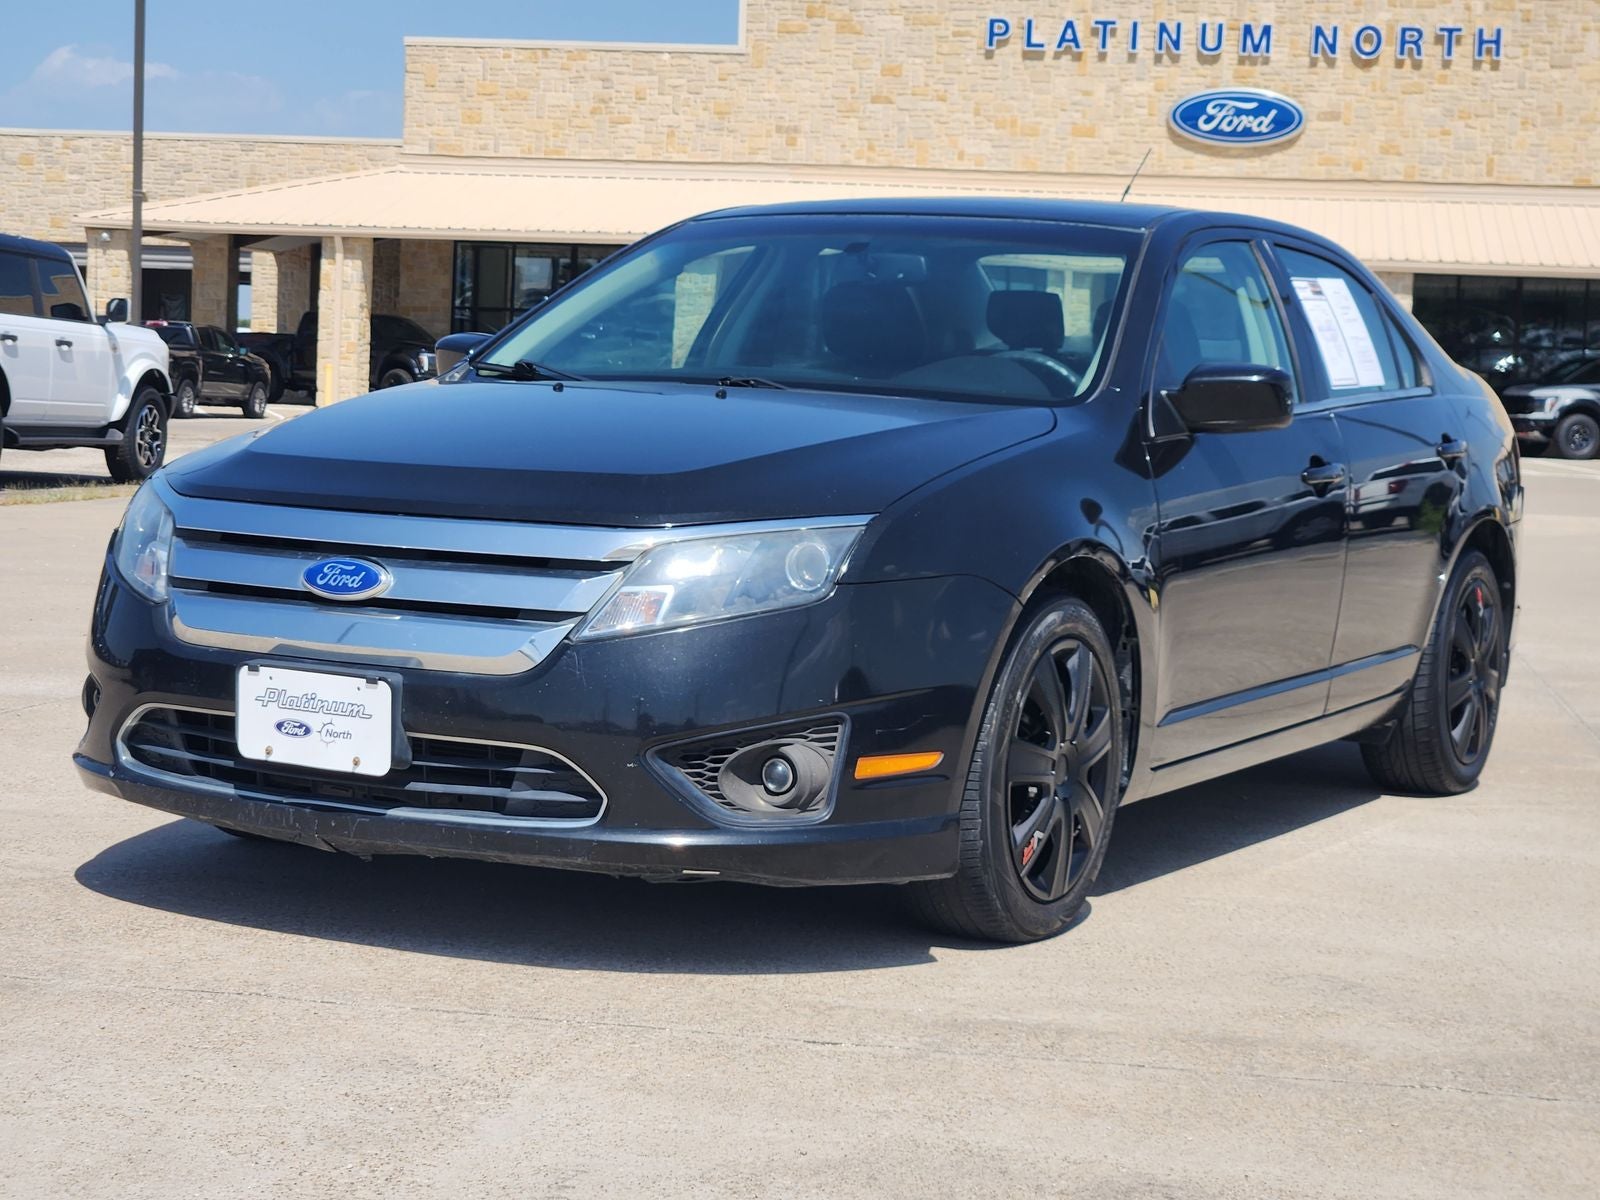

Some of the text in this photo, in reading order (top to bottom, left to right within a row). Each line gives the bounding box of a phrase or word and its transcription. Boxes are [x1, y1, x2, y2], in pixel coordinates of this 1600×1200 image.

[986, 17, 1503, 59] PLATINUM NORTH
[1197, 98, 1276, 134] Ford
[316, 562, 364, 589] Ford
[254, 687, 373, 720] Platinum
[280, 720, 306, 736] Ford
[324, 728, 353, 741] North
